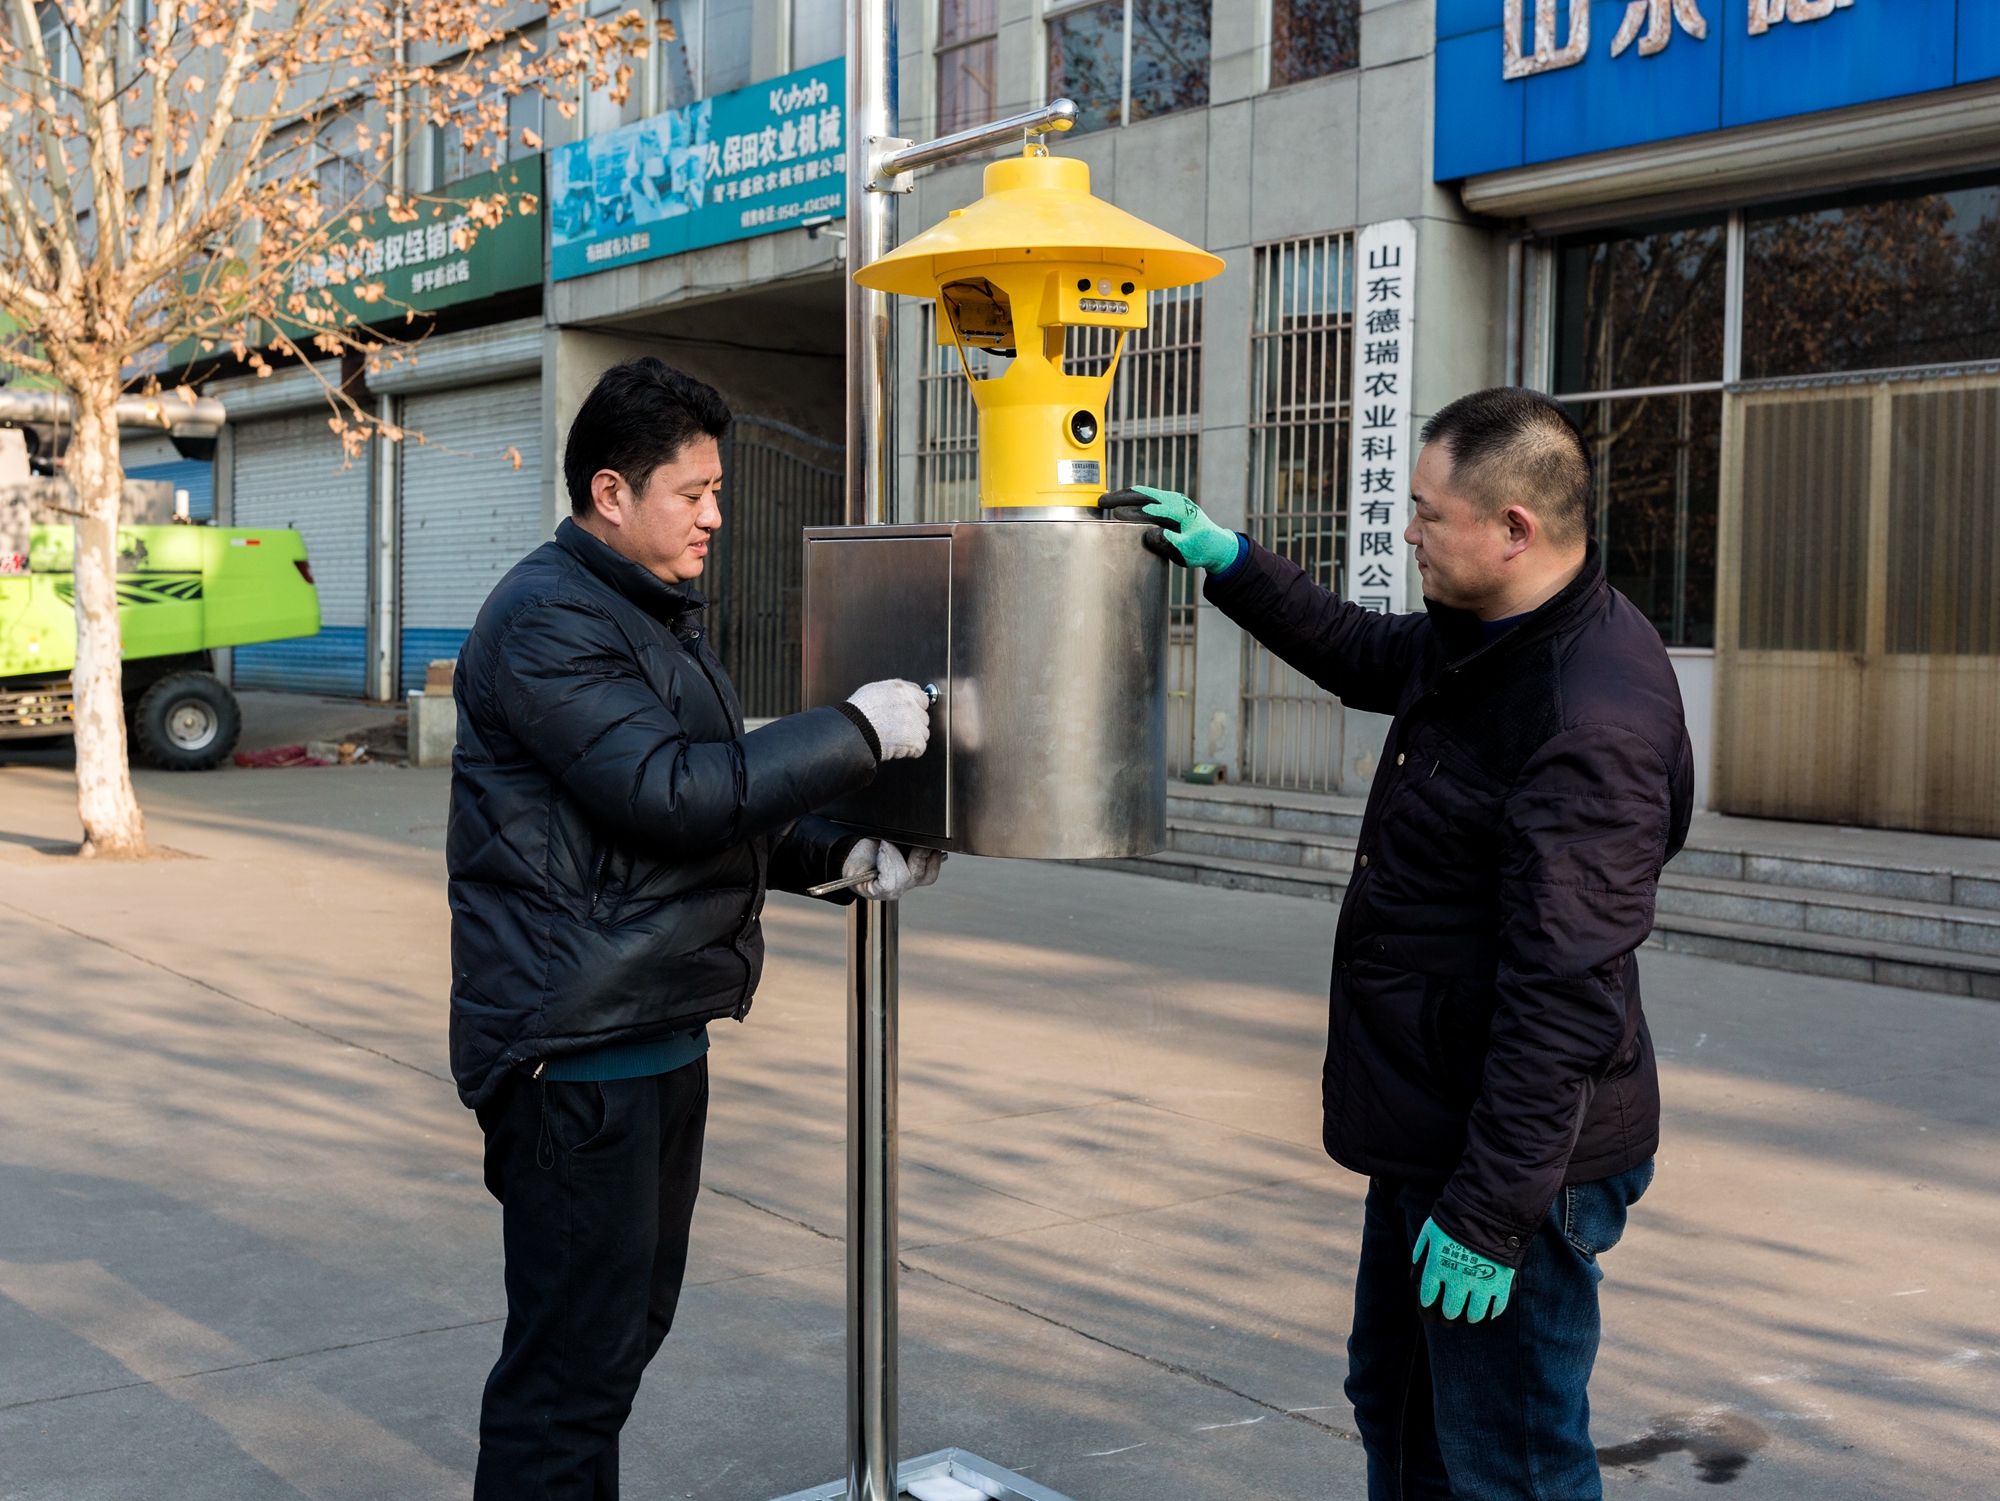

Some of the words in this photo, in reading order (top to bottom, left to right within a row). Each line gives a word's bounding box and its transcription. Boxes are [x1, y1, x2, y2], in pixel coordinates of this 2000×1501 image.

[770, 78, 828, 115] Kubota
[705, 105, 841, 181] 久保田农业机械
[1357, 244, 1401, 613] 山东德瑞农业科技有限公司
